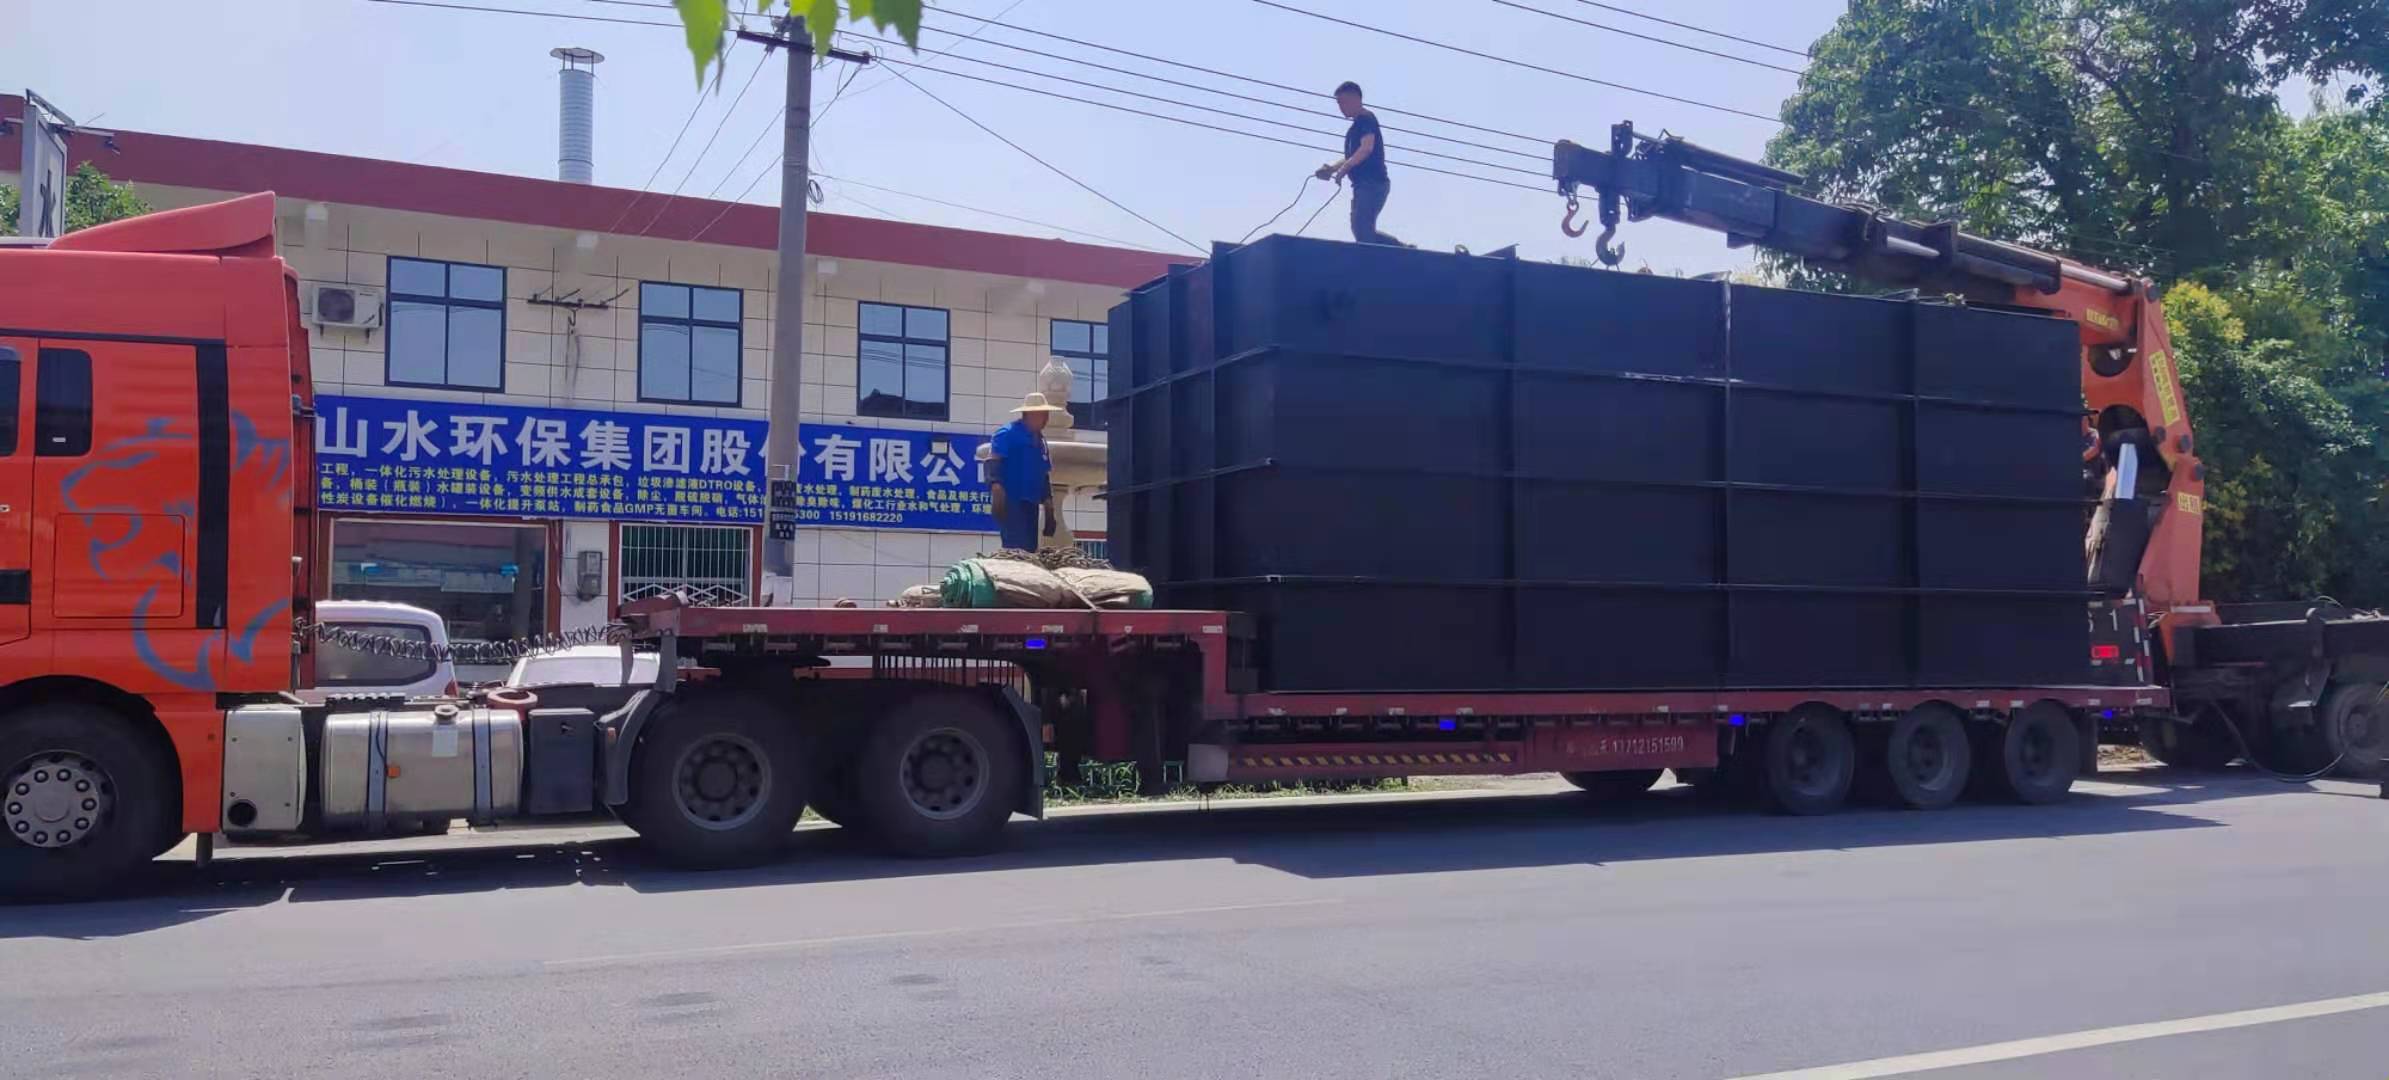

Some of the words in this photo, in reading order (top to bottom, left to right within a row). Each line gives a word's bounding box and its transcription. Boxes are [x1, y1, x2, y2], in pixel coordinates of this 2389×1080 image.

[315, 406, 985, 486] 山水环保集团股有限公
[830, 510, 904, 523] 15191682220
